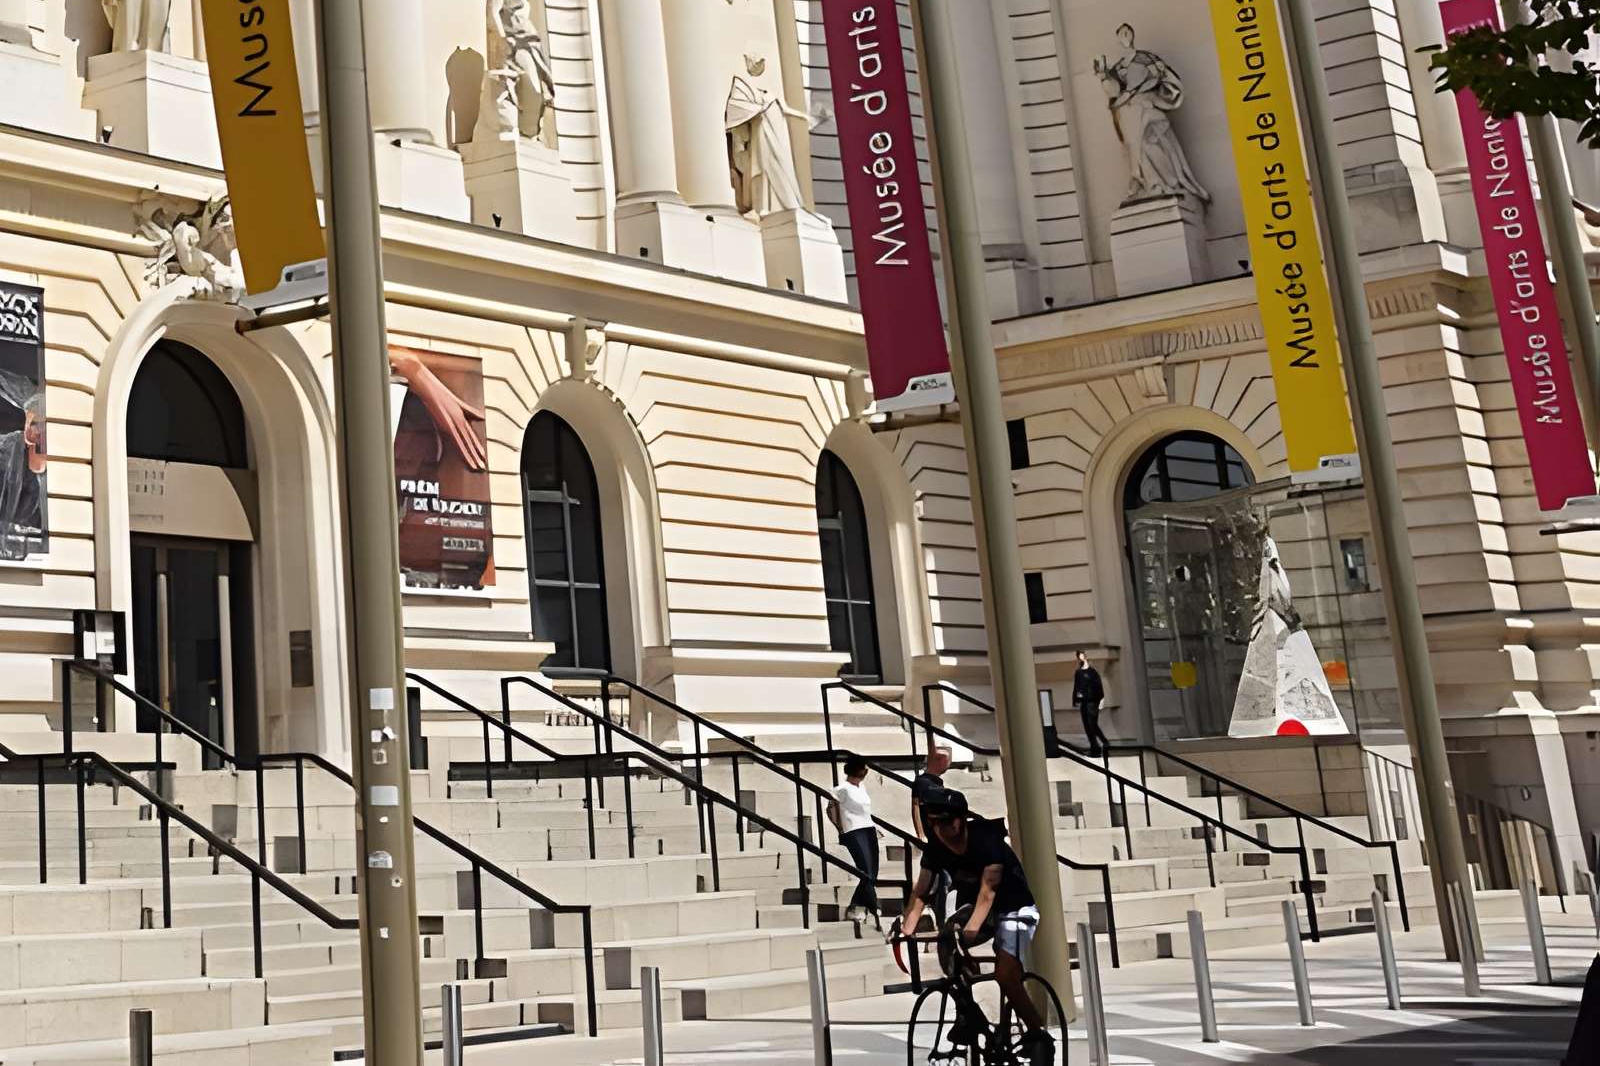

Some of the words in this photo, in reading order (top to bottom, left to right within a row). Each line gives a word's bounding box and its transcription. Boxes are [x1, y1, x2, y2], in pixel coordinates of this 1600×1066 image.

[848, 6, 887, 115] d'arts
[1247, 112, 1280, 150] de
[863, 132, 909, 265] Musée
[1261, 162, 1297, 250] d'arts
[1493, 206, 1522, 238] de
[1275, 262, 1320, 368] Musée
